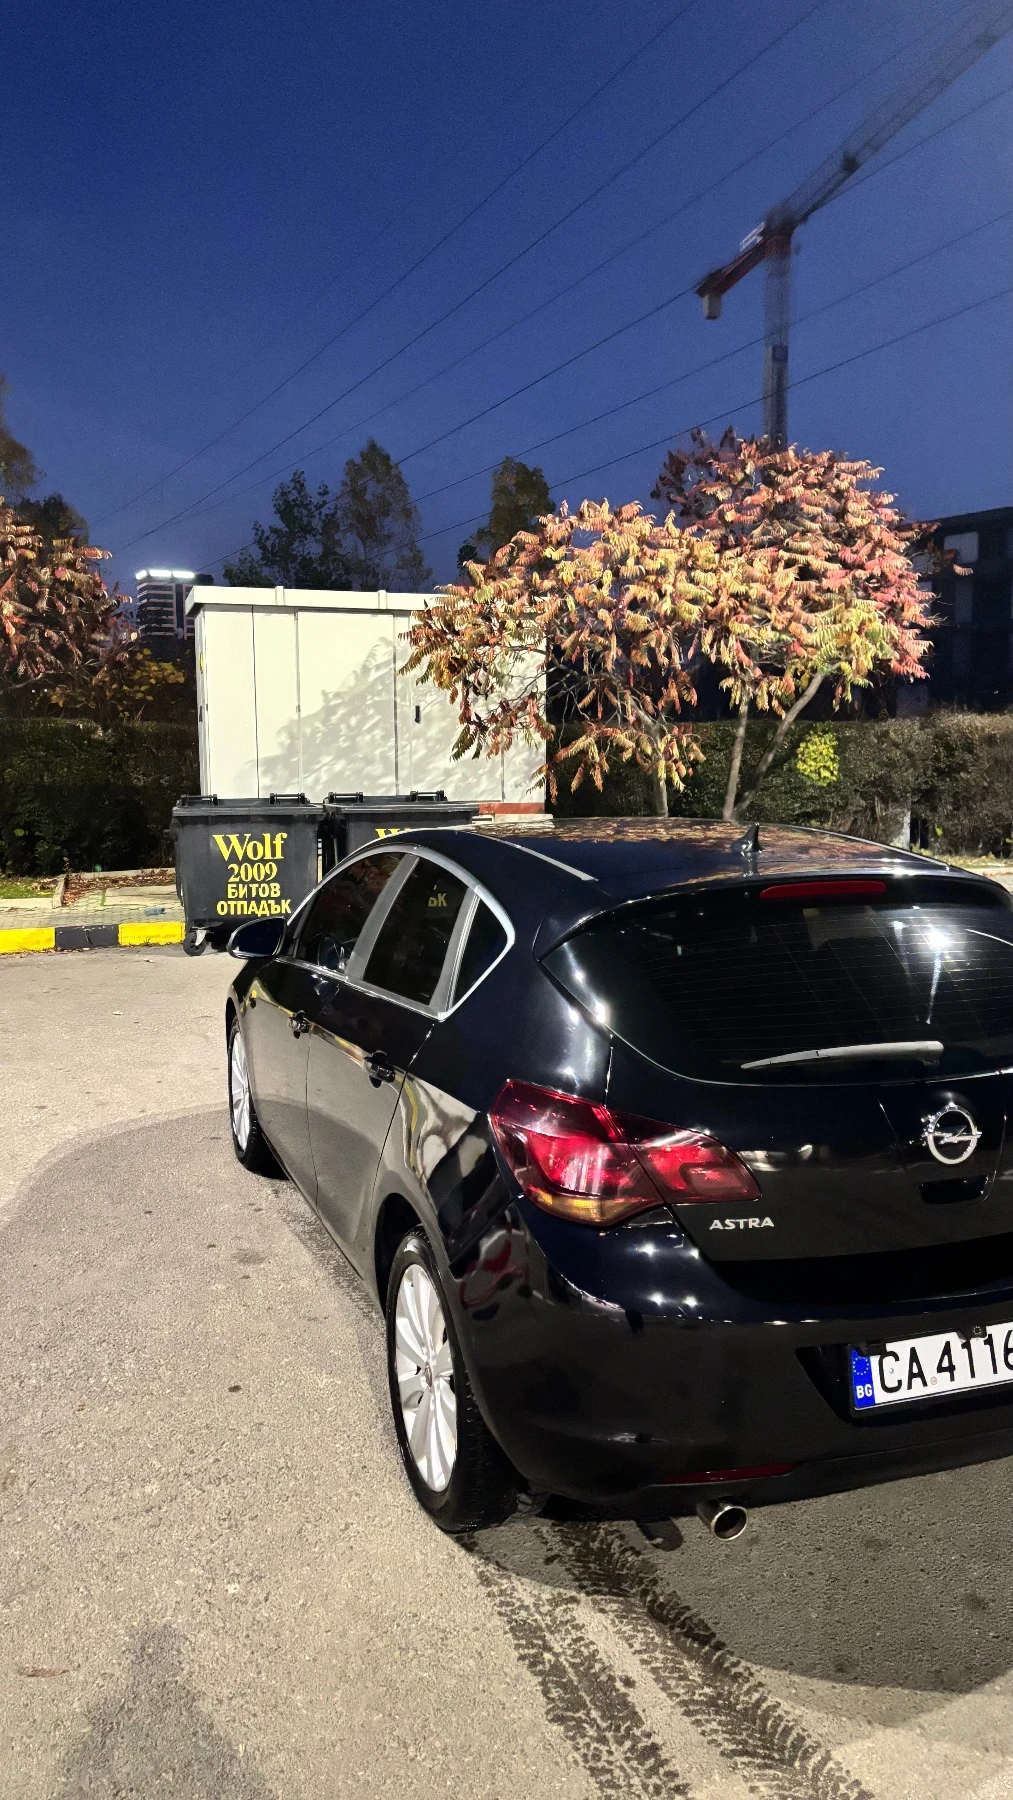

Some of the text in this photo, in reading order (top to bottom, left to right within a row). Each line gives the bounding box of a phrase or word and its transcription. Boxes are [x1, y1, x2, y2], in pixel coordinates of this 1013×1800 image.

[212, 832, 287, 861] Wolf
[227, 862, 278, 882] 2009
[227, 883, 281, 898] БИТОВ
[216, 899, 292, 917] ОТПАДЪК
[709, 1216, 775, 1231] ASTRA
[856, 1384, 873, 1399] BG
